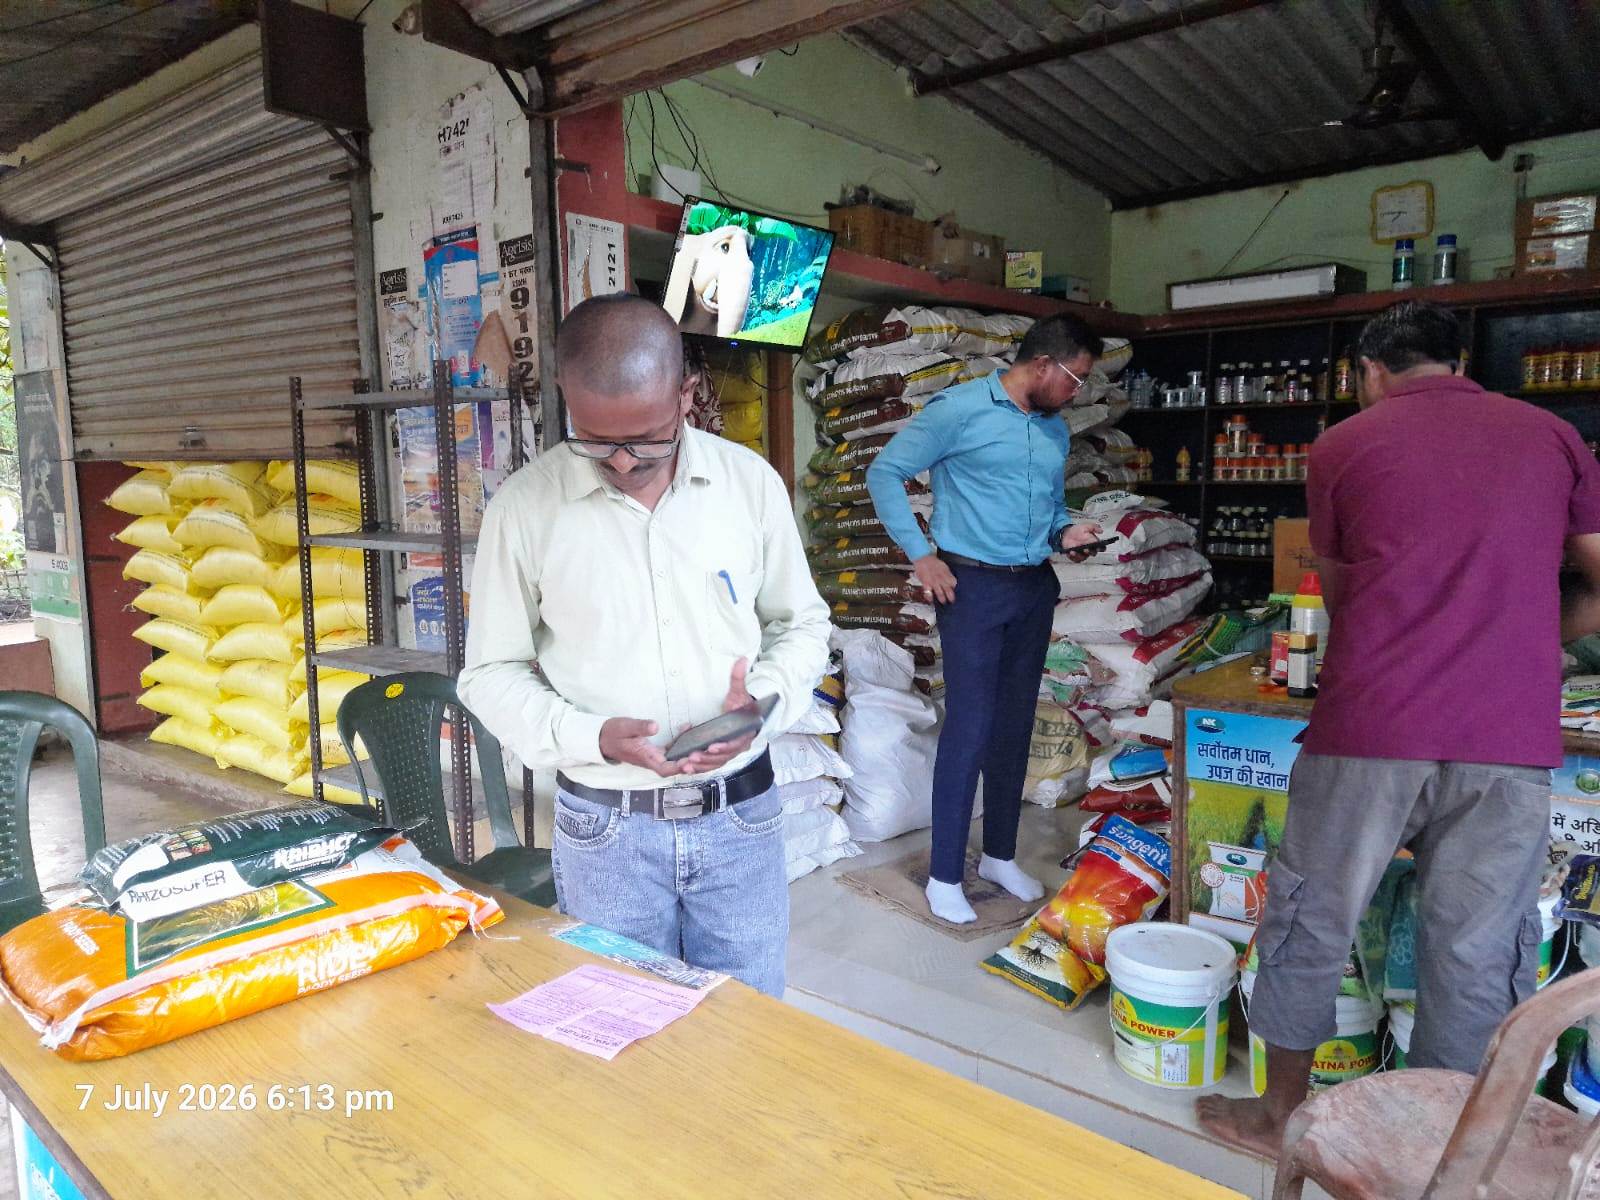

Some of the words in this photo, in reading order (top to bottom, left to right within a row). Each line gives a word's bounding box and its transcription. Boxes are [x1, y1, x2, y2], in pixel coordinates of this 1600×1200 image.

[607, 243, 616, 288] 2121
[509, 286, 534, 383] 9192
[1202, 717, 1217, 727] NK
[1206, 764, 1234, 782] उपज
[1235, 765, 1254, 785] की
[1255, 770, 1289, 790] खान
[1130, 1020, 1176, 1039] POWER
[1311, 1059, 1345, 1071] ATNA
